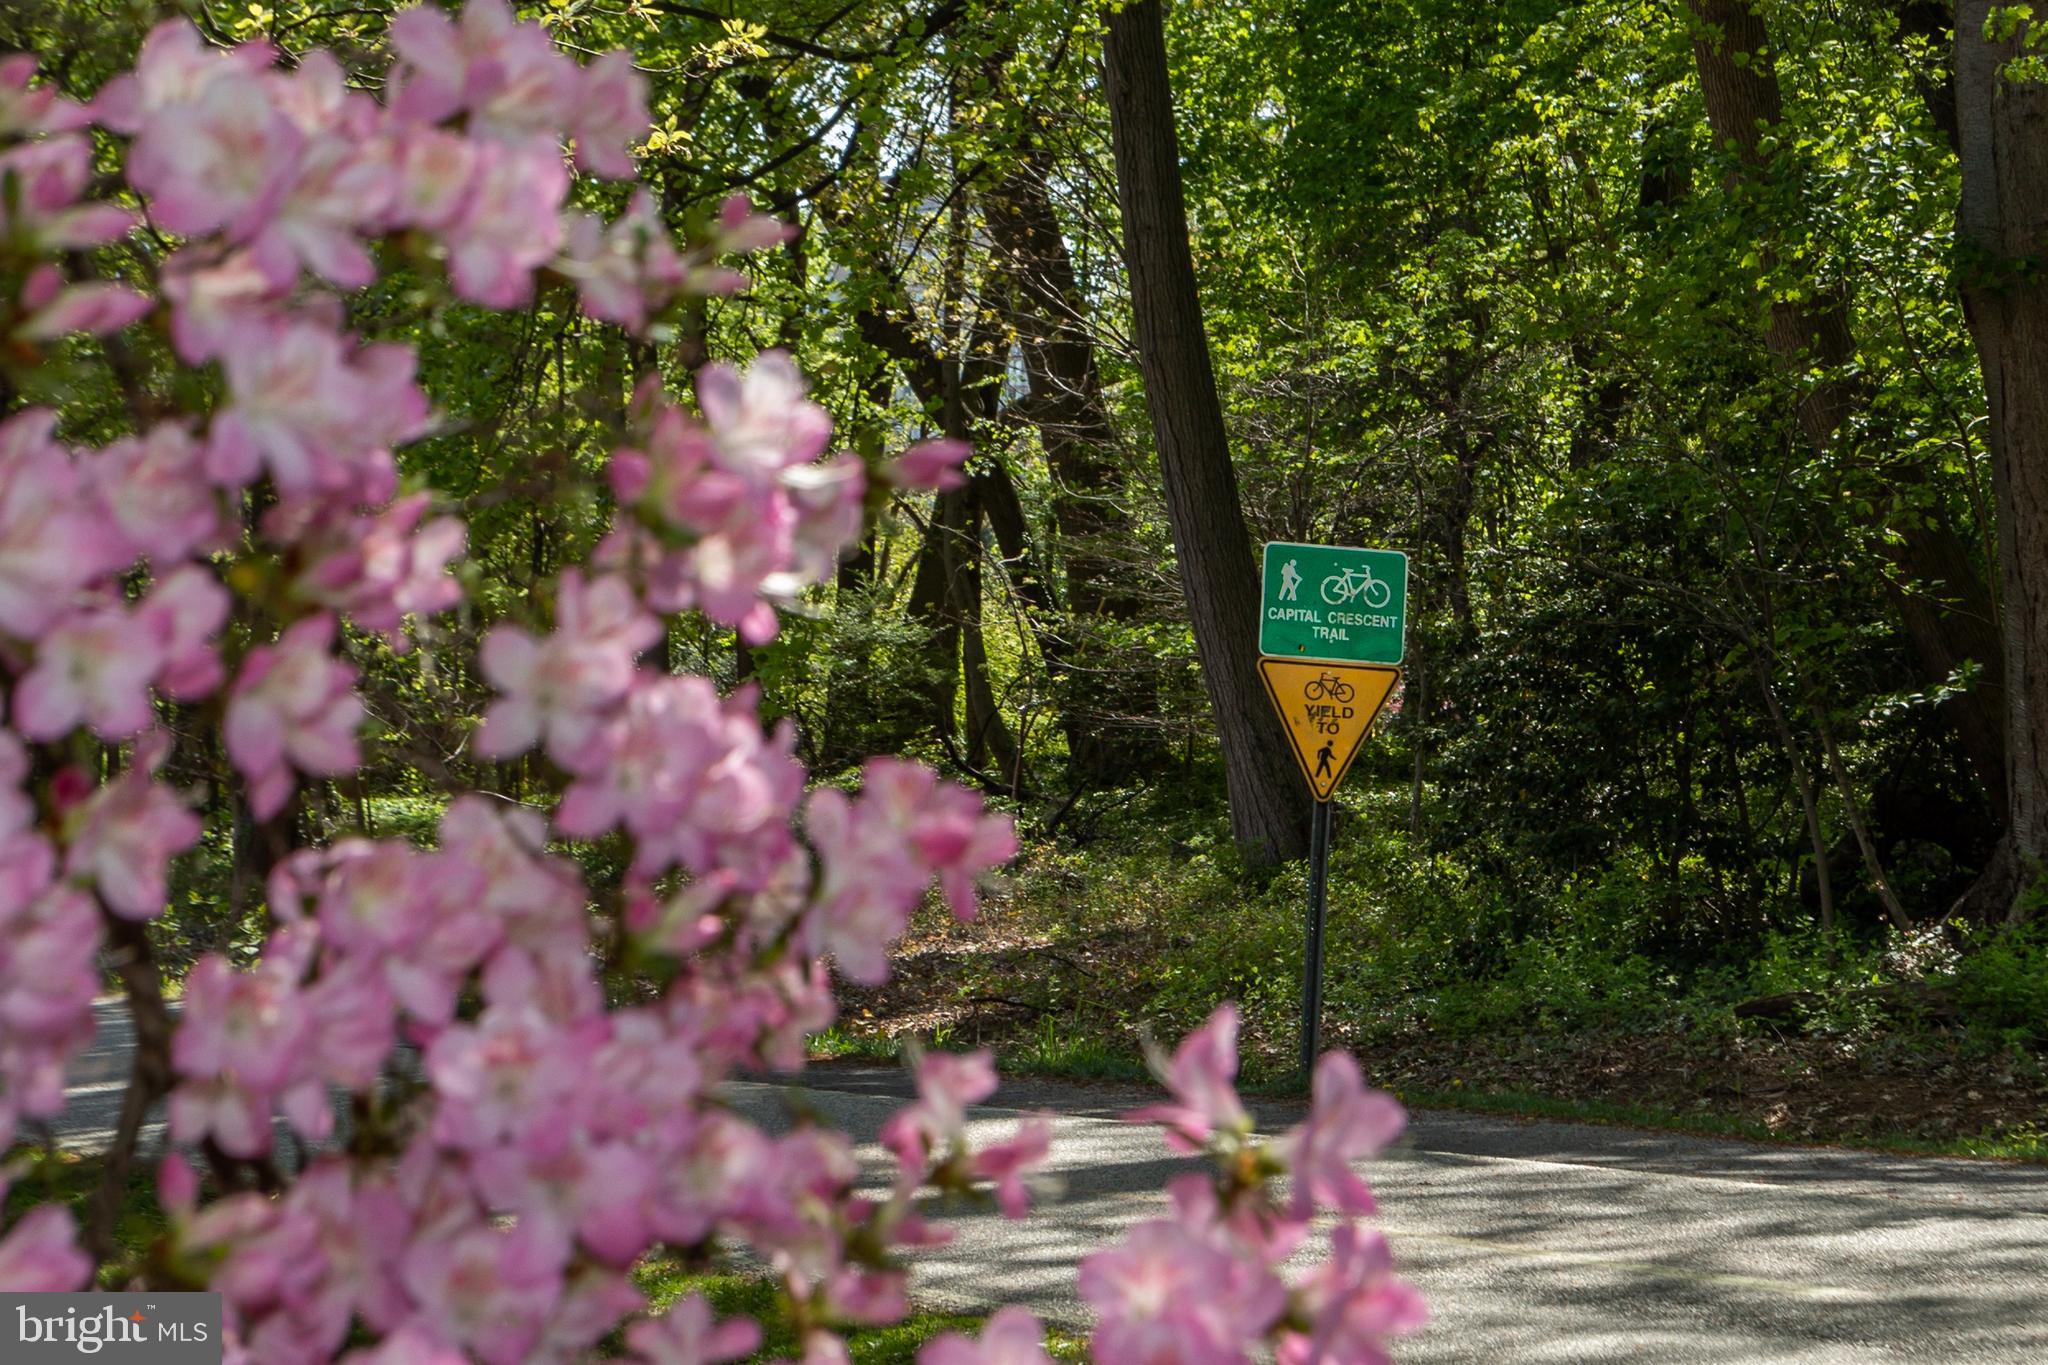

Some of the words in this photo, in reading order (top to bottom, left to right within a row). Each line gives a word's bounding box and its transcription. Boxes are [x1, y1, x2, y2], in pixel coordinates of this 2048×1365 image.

[1267, 607, 1322, 623] CAPITAL
[1327, 611, 1398, 628] CRESCENT
[1312, 626, 1349, 640] TRAIL
[1304, 704, 1354, 719] YIELD
[1317, 722, 1340, 735] TO
